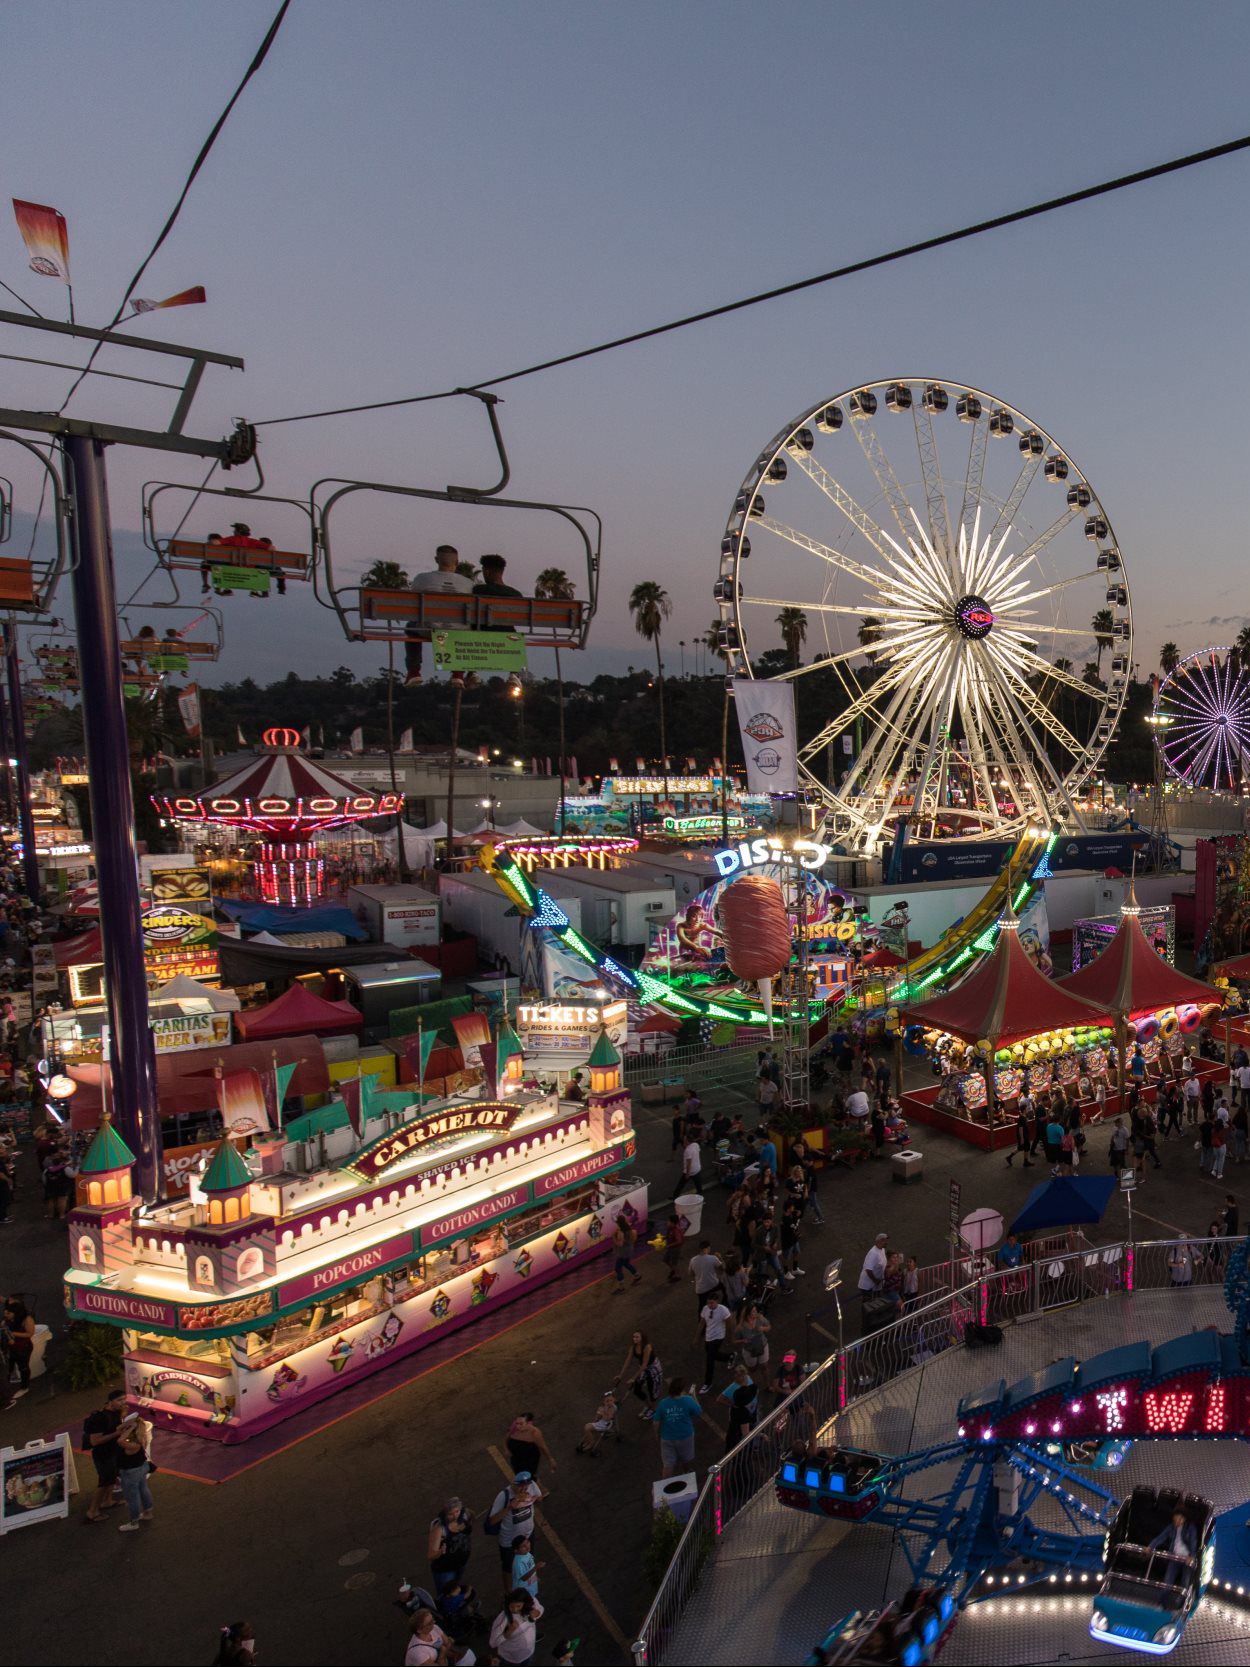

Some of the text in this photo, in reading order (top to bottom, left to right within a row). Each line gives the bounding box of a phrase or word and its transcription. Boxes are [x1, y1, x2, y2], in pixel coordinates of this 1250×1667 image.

[435, 653, 451, 663] 32
[151, 1015, 209, 1034] GARITAS
[519, 1006, 599, 1024] TICKETS
[155, 1033, 190, 1048] BEER
[374, 1110, 508, 1167] CARMELOT
[417, 1154, 477, 1181] SHAVED ICE
[544, 1151, 615, 1190] CANDY APPLES
[431, 1191, 518, 1238] COTTON CANDY
[312, 1248, 383, 1289] POPCORN
[86, 1292, 166, 1321] COTTON CANDY
[158, 1372, 207, 1391] CARMELOT
